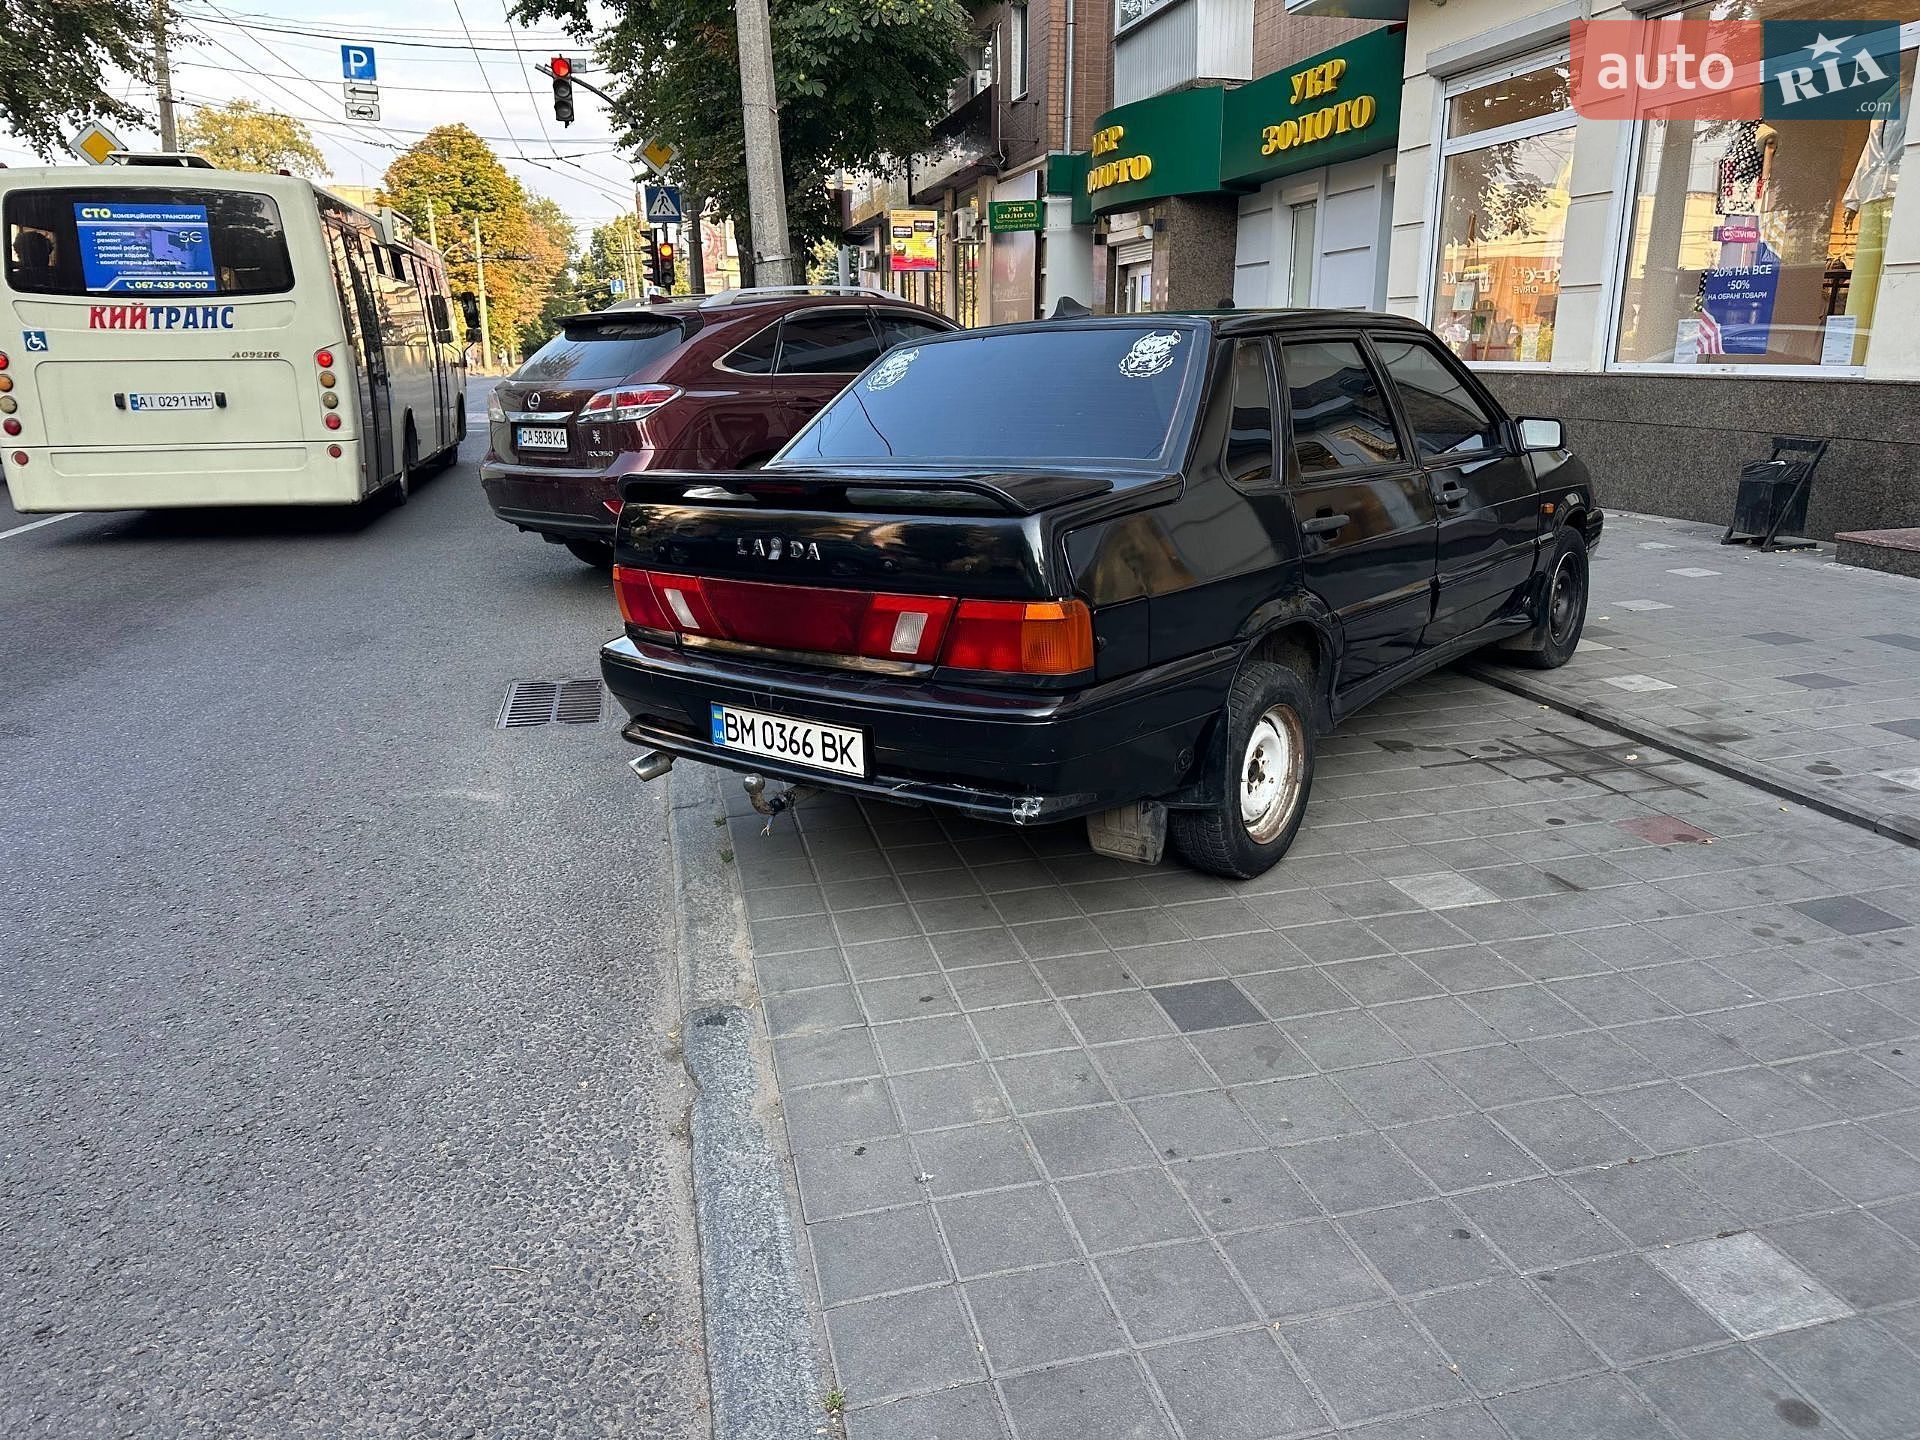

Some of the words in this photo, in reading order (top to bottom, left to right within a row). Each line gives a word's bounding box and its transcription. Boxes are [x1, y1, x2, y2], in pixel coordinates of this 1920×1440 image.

[348, 49, 368, 76] P
[1290, 59, 1347, 105] УКР
[1261, 95, 1376, 155] ЗОЛОТО
[1087, 154, 1152, 194] ОЛОТО
[81, 208, 112, 219] СТО
[1712, 267, 1733, 278] -20%
[1735, 266, 1749, 276] НА
[1752, 264, 1773, 275] ВСЕ
[135, 281, 208, 289] 067-439-00-00
[1717, 292, 1740, 300] ОБРАНІ
[1742, 291, 1767, 299] ТОВАРИ
[89, 302, 234, 330] КИЙТРАНС
[139, 396, 153, 407] AI
[158, 396, 186, 407] 0291
[188, 395, 208, 407] HM
[522, 430, 533, 444] CA
[534, 430, 553, 444] 5838
[553, 431, 566, 445] KA
[737, 537, 821, 560] LADA
[715, 732, 724, 740] UA
[725, 712, 756, 747] BM
[762, 721, 814, 758] 0366
[821, 731, 857, 768] BK
